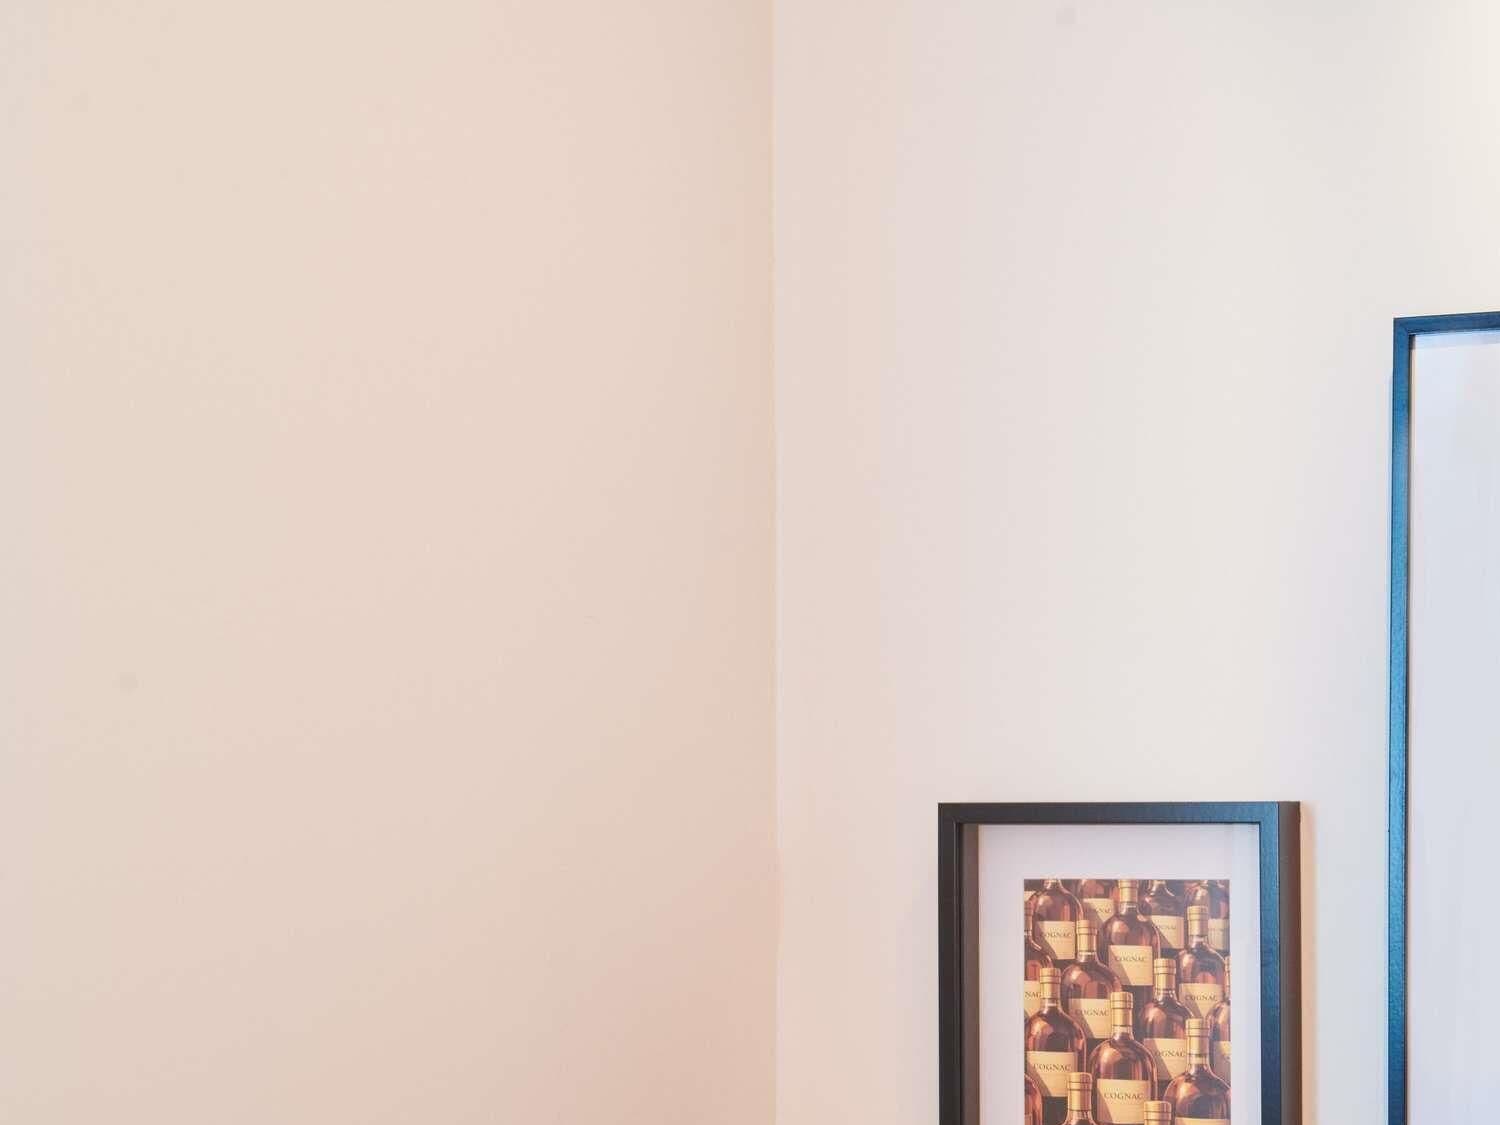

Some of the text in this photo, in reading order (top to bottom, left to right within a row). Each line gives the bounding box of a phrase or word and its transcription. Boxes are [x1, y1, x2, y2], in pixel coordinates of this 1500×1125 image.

[1114, 954, 1147, 963] COGNAC
[1033, 1063, 1071, 1072] COGNAC
[1104, 1092, 1144, 1101] COGNAC
